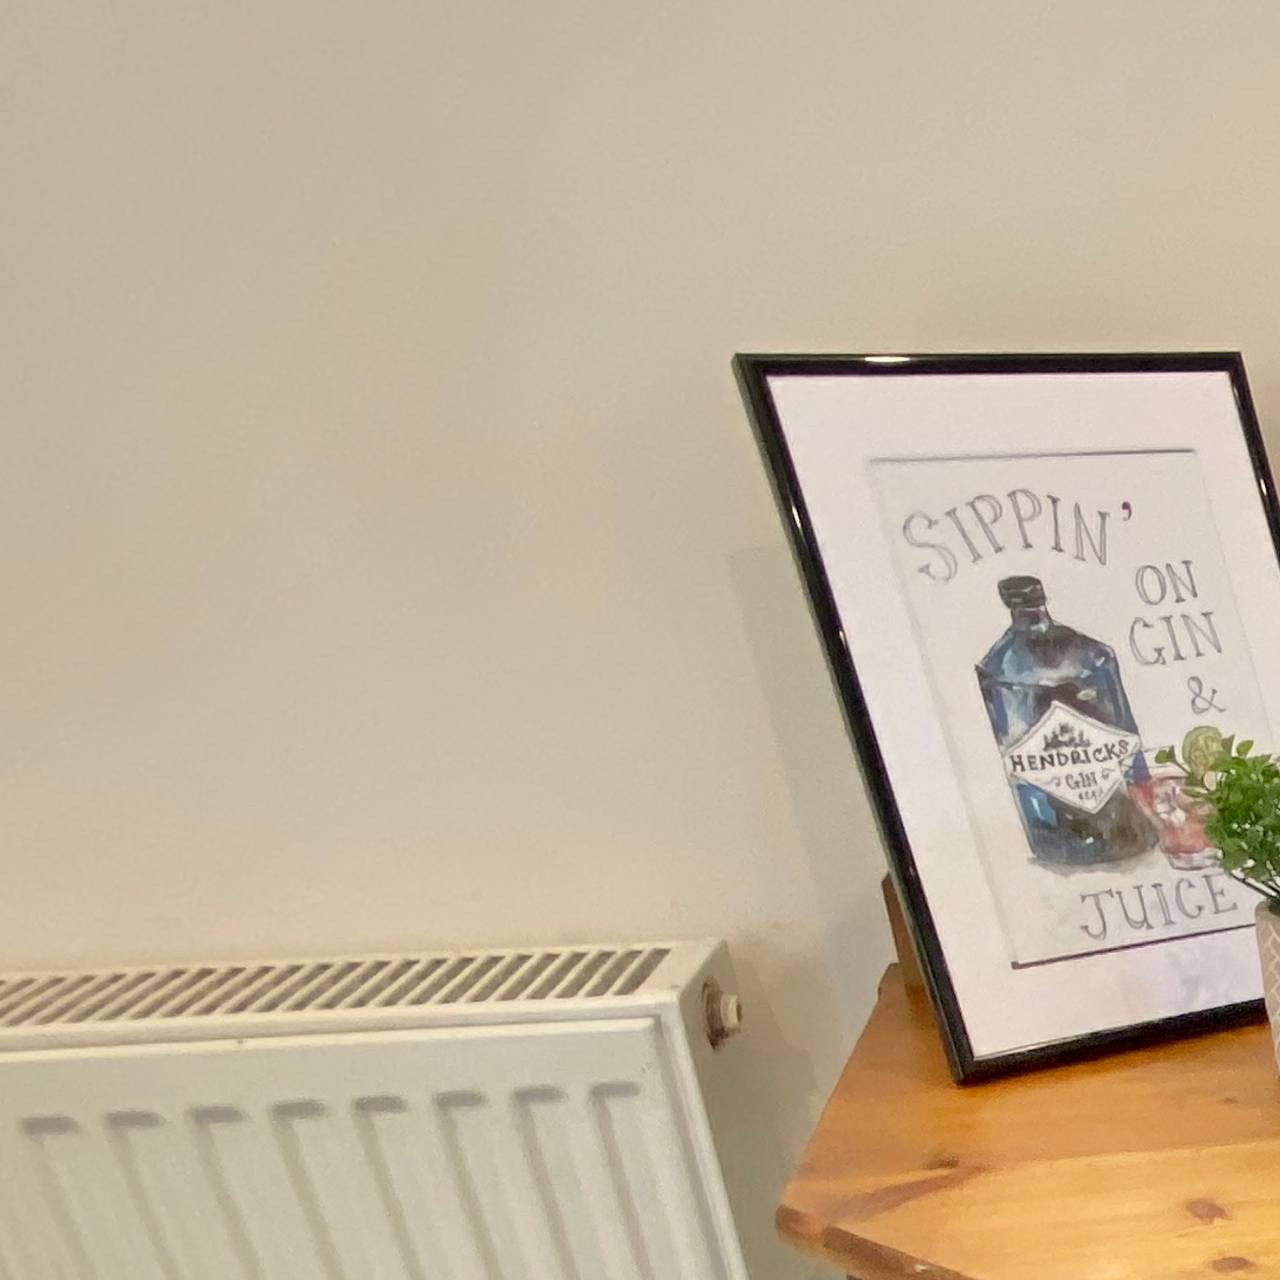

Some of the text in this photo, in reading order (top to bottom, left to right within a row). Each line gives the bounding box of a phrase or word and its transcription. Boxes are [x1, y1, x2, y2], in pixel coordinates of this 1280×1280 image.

[902, 488, 1132, 582] SIPPIN'
[1135, 559, 1199, 606] ON
[1128, 611, 1223, 666] GIN
[1187, 675, 1227, 715] &
[1009, 739, 1129, 773] HENDRICKS
[1065, 771, 1098, 790] GIN
[1079, 872, 1238, 941] JUICE
